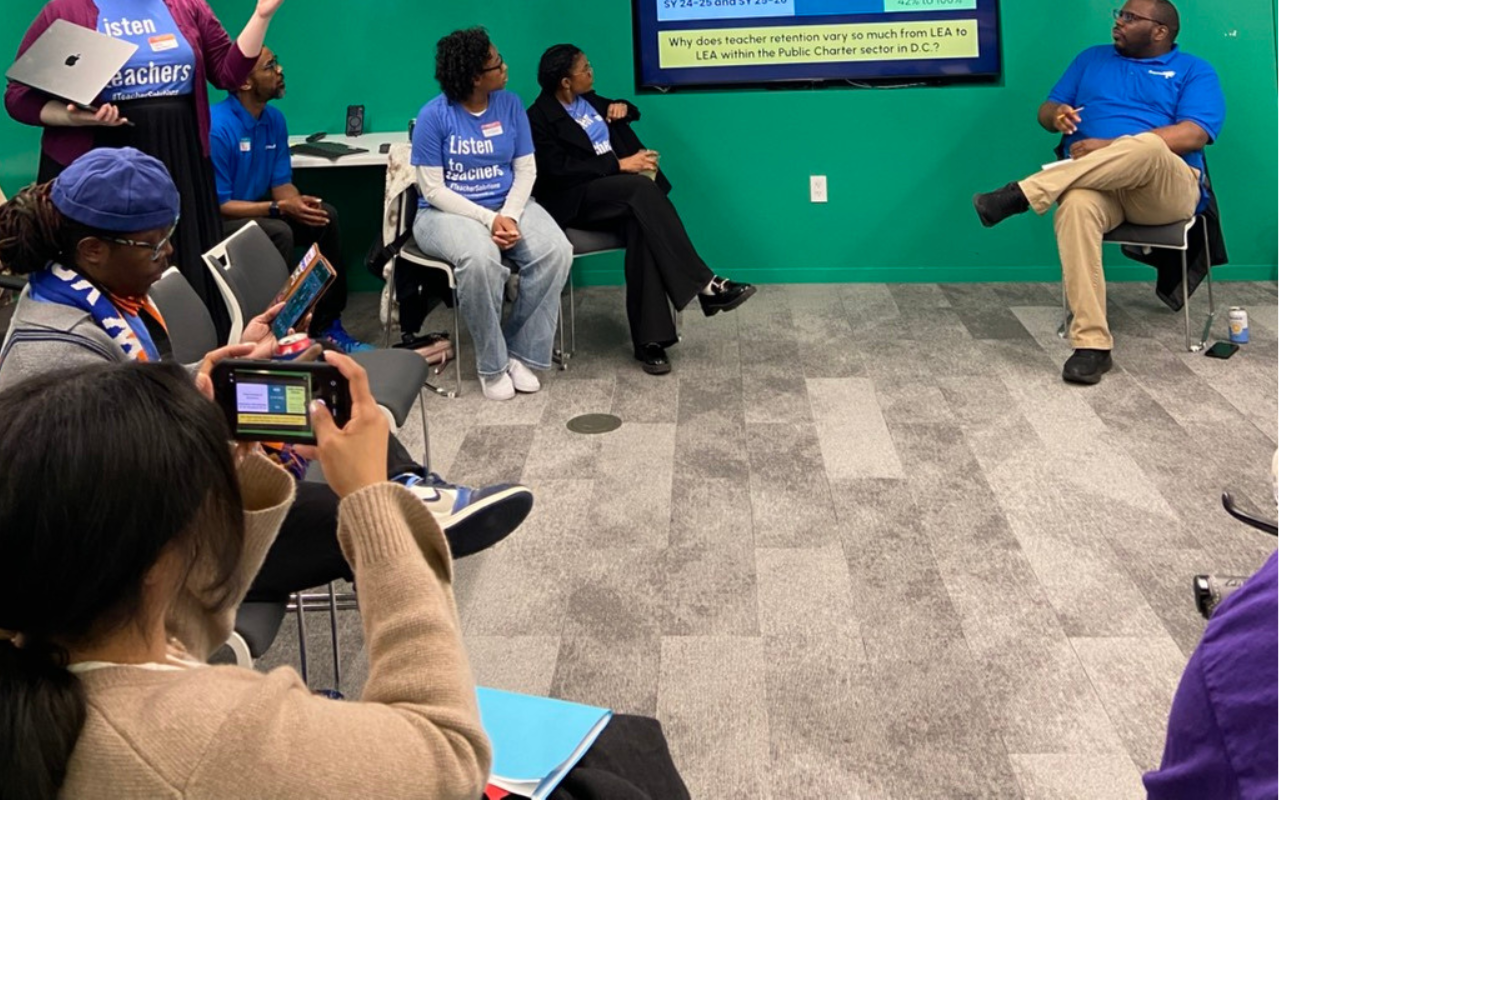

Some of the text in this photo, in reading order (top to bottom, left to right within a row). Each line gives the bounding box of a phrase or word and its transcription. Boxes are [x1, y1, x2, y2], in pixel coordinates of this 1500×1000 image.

[663, 0, 678, 9] SY
[102, 18, 156, 37] isten
[669, 27, 967, 49] Why does teacher retention vary so much from LEA to
[696, 42, 940, 61] LEA within the Public Charter sector in D.C.?
[450, 135, 494, 155] Listen
[448, 158, 464, 173] to
